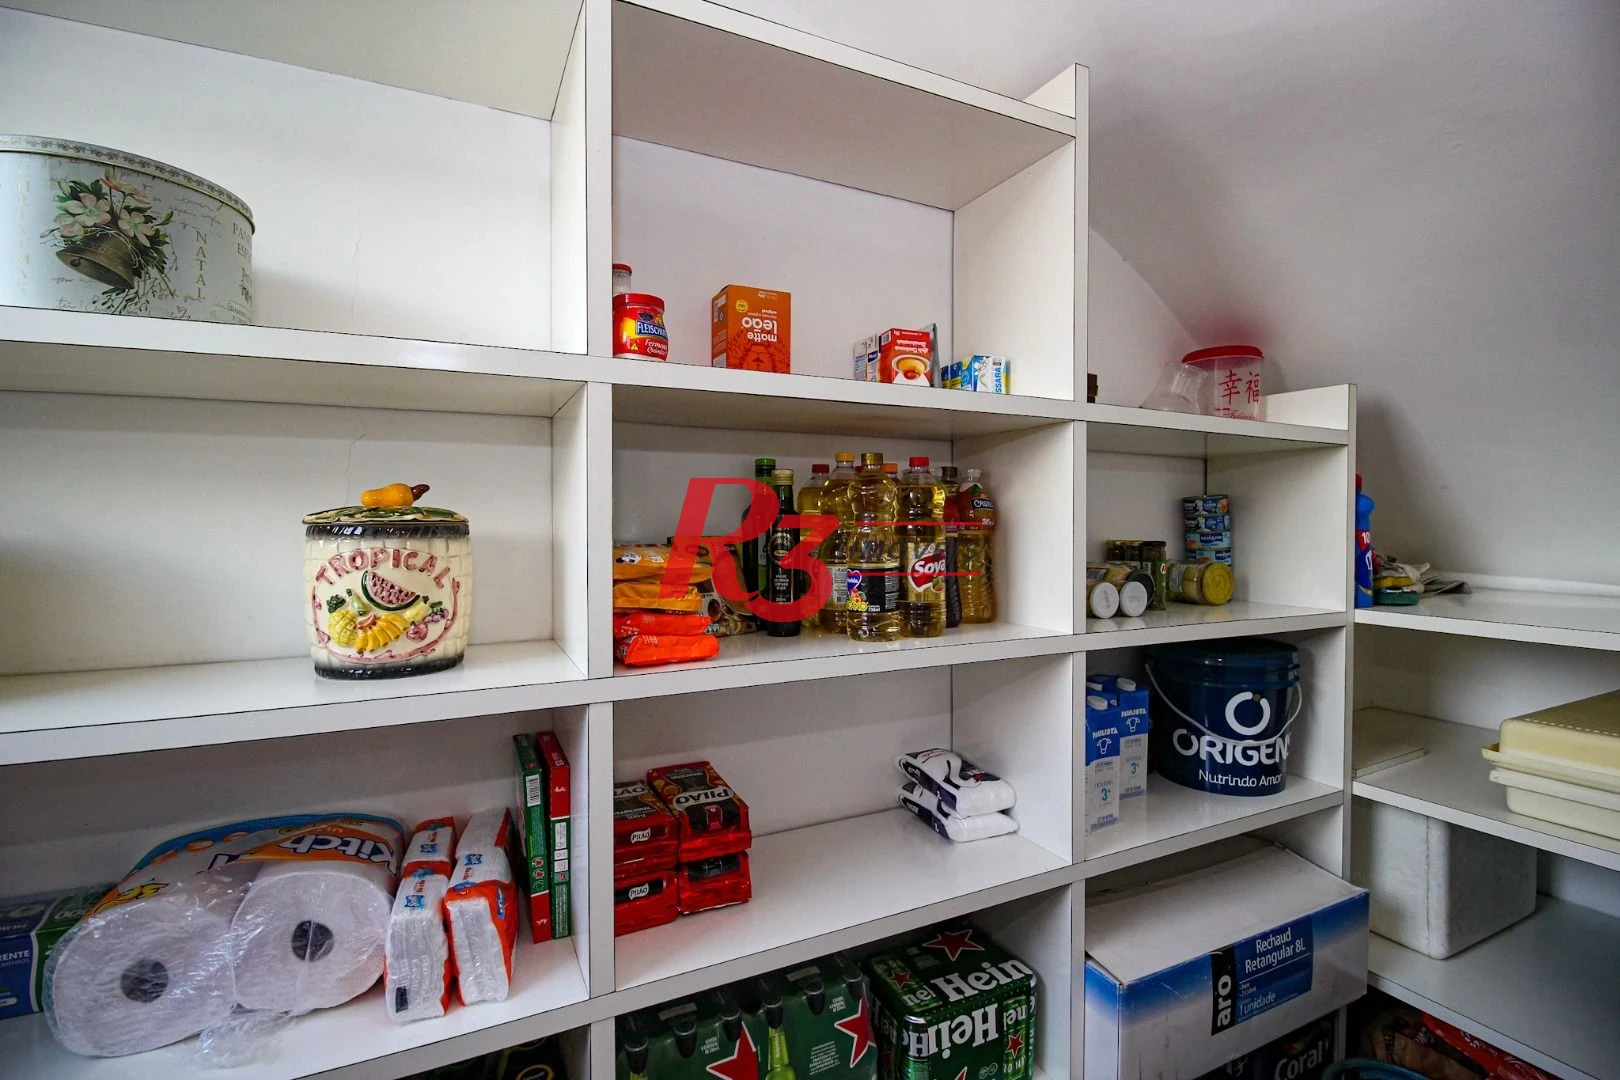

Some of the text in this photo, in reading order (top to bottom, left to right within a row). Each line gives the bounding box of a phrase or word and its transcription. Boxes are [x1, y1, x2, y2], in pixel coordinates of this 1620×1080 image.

[194, 230, 209, 299] NATAL
[742, 317, 778, 334] leão
[747, 332, 778, 343] matte
[315, 547, 451, 590] TROPICAL
[914, 559, 946, 578] Soya
[1198, 768, 1257, 787] Nutrindo
[1245, 938, 1306, 974] Retangular 8L
[1255, 927, 1292, 954] Rechaud
[931, 959, 1034, 1002] Hein
[1216, 974, 1232, 1027] aro
[1273, 1038, 1324, 1080] Coral
